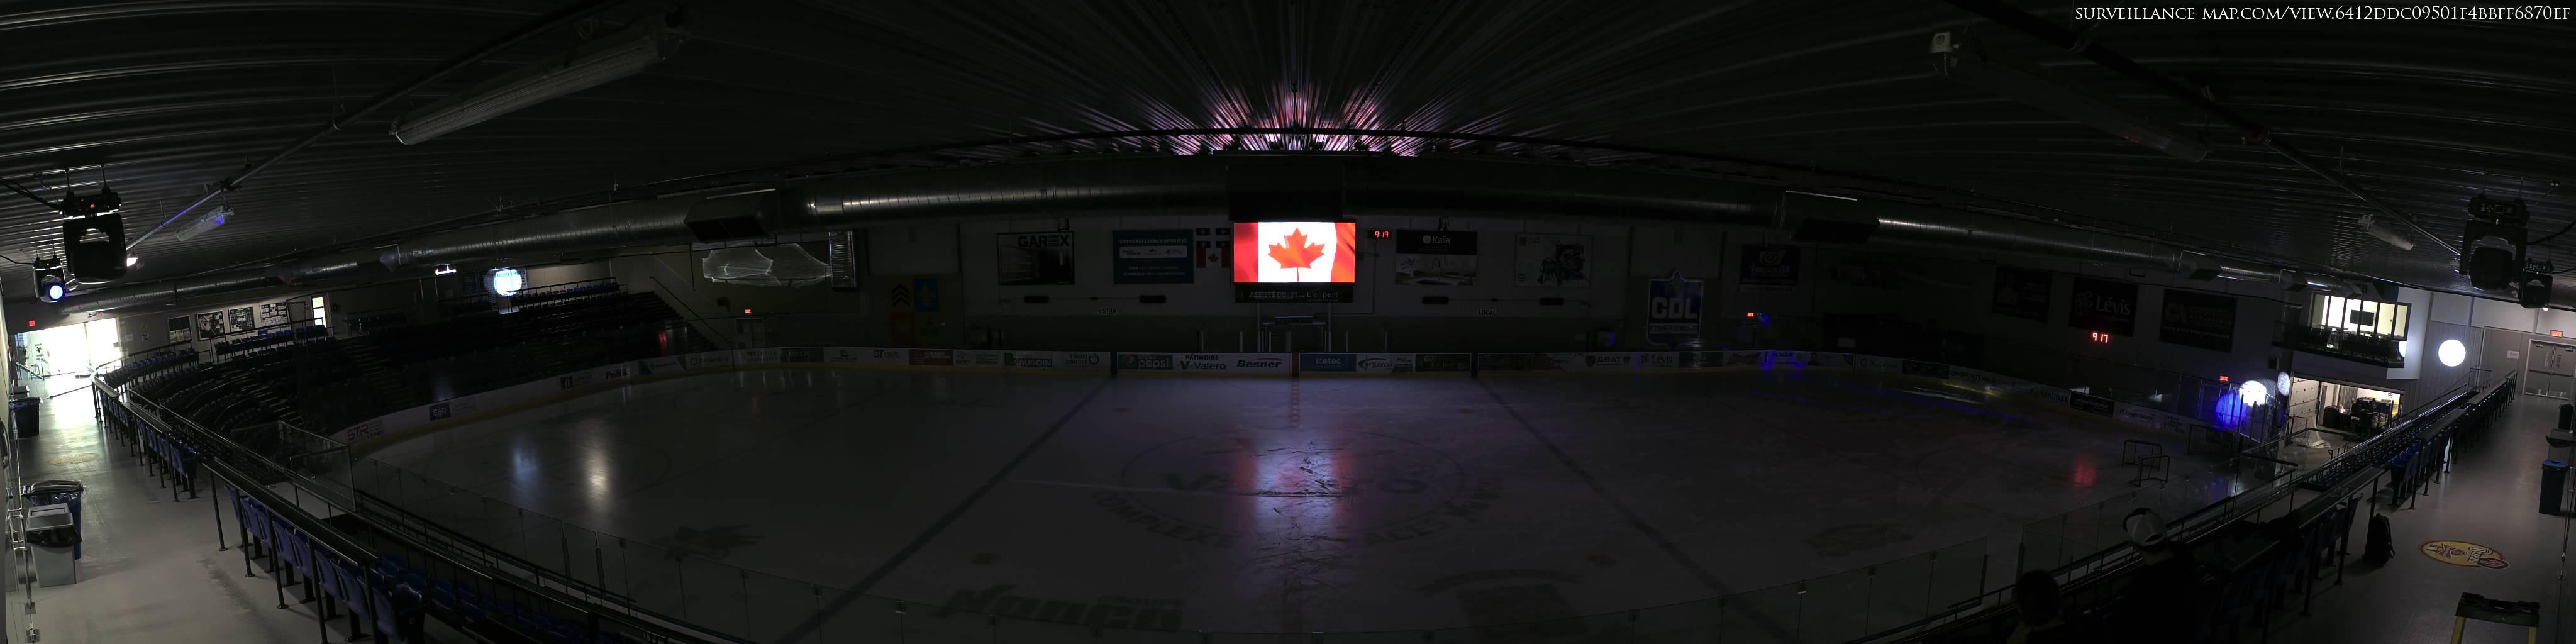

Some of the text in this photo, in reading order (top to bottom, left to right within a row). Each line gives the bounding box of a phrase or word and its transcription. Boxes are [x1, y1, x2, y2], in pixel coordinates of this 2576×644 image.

[1651, 297, 1698, 319] CDL
[2095, 294, 2132, 316] Lévis
[1138, 358, 1169, 370] pepsi
[1194, 361, 1227, 370] Valero
[1236, 360, 1282, 368] Besner
